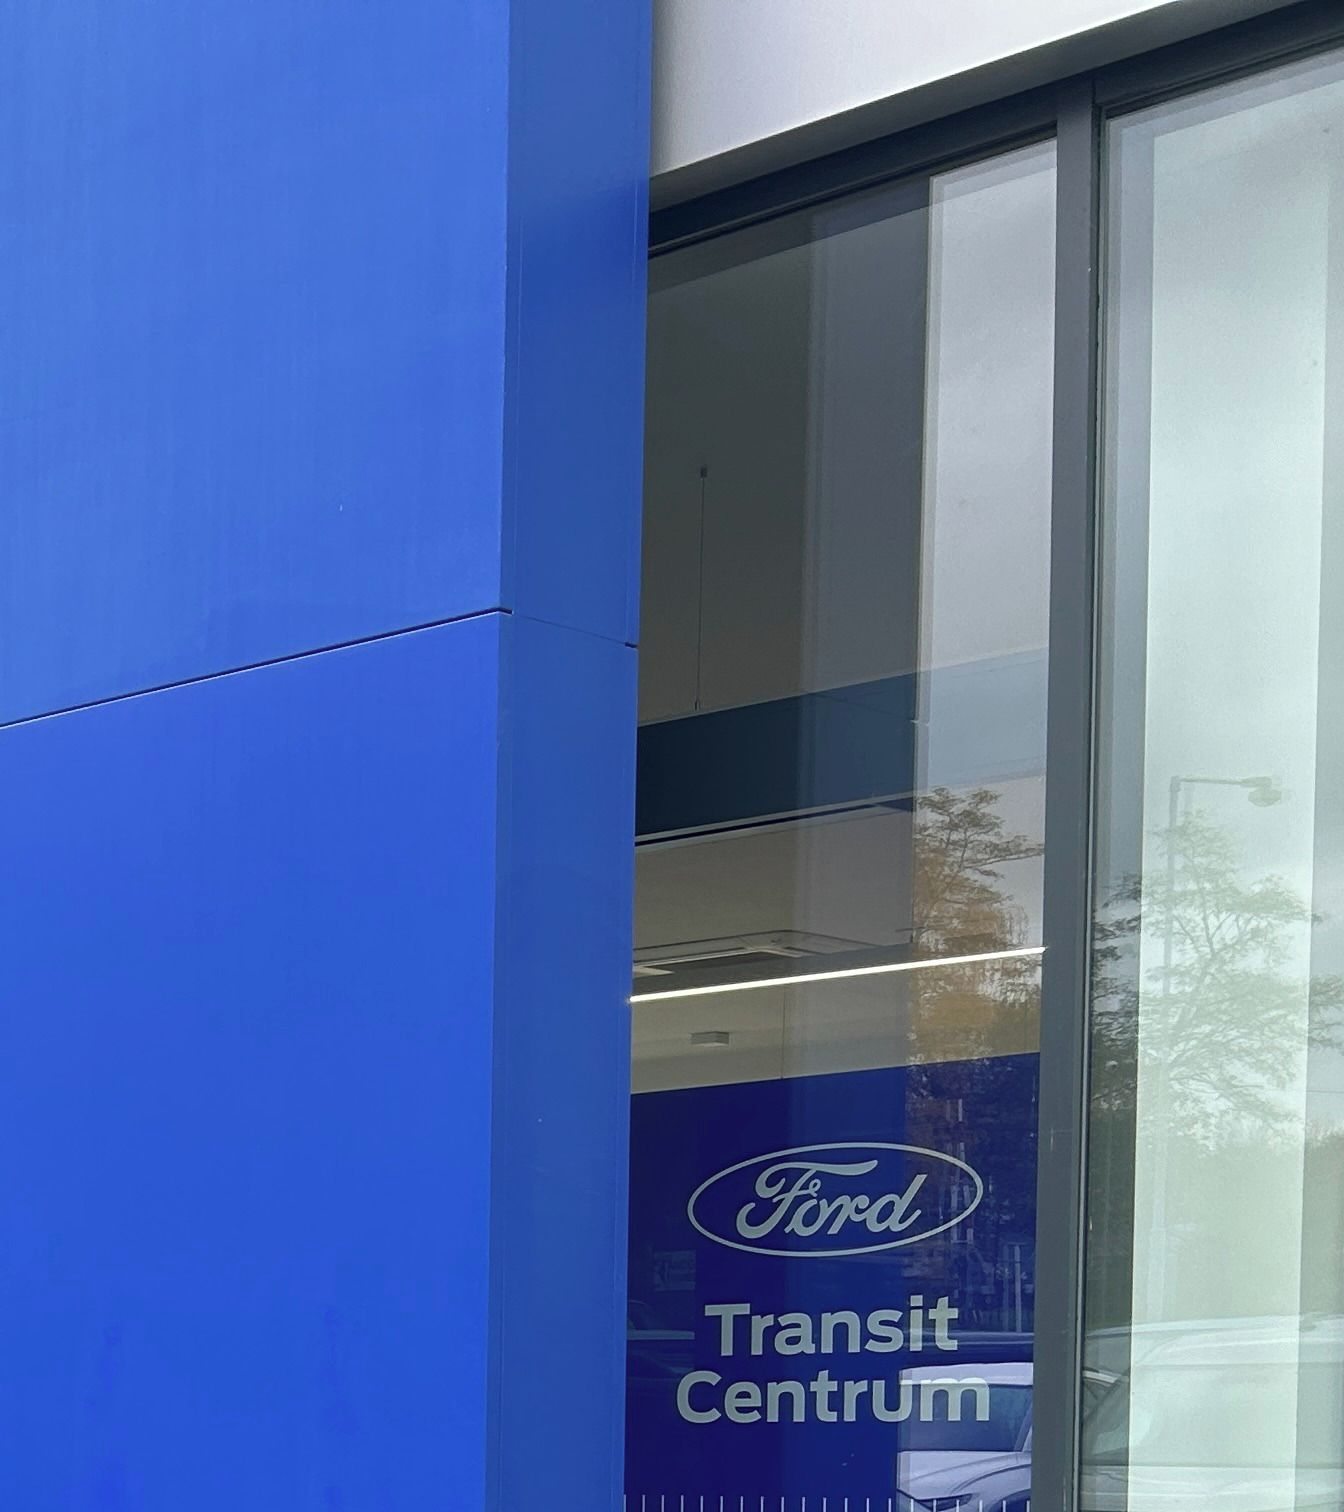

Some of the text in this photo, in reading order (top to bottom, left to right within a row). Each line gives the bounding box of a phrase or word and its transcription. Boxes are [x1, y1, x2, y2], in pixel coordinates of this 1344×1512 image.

[736, 1159, 928, 1239] Ford
[704, 1294, 959, 1357] Transit
[676, 1369, 990, 1424] Centrum
